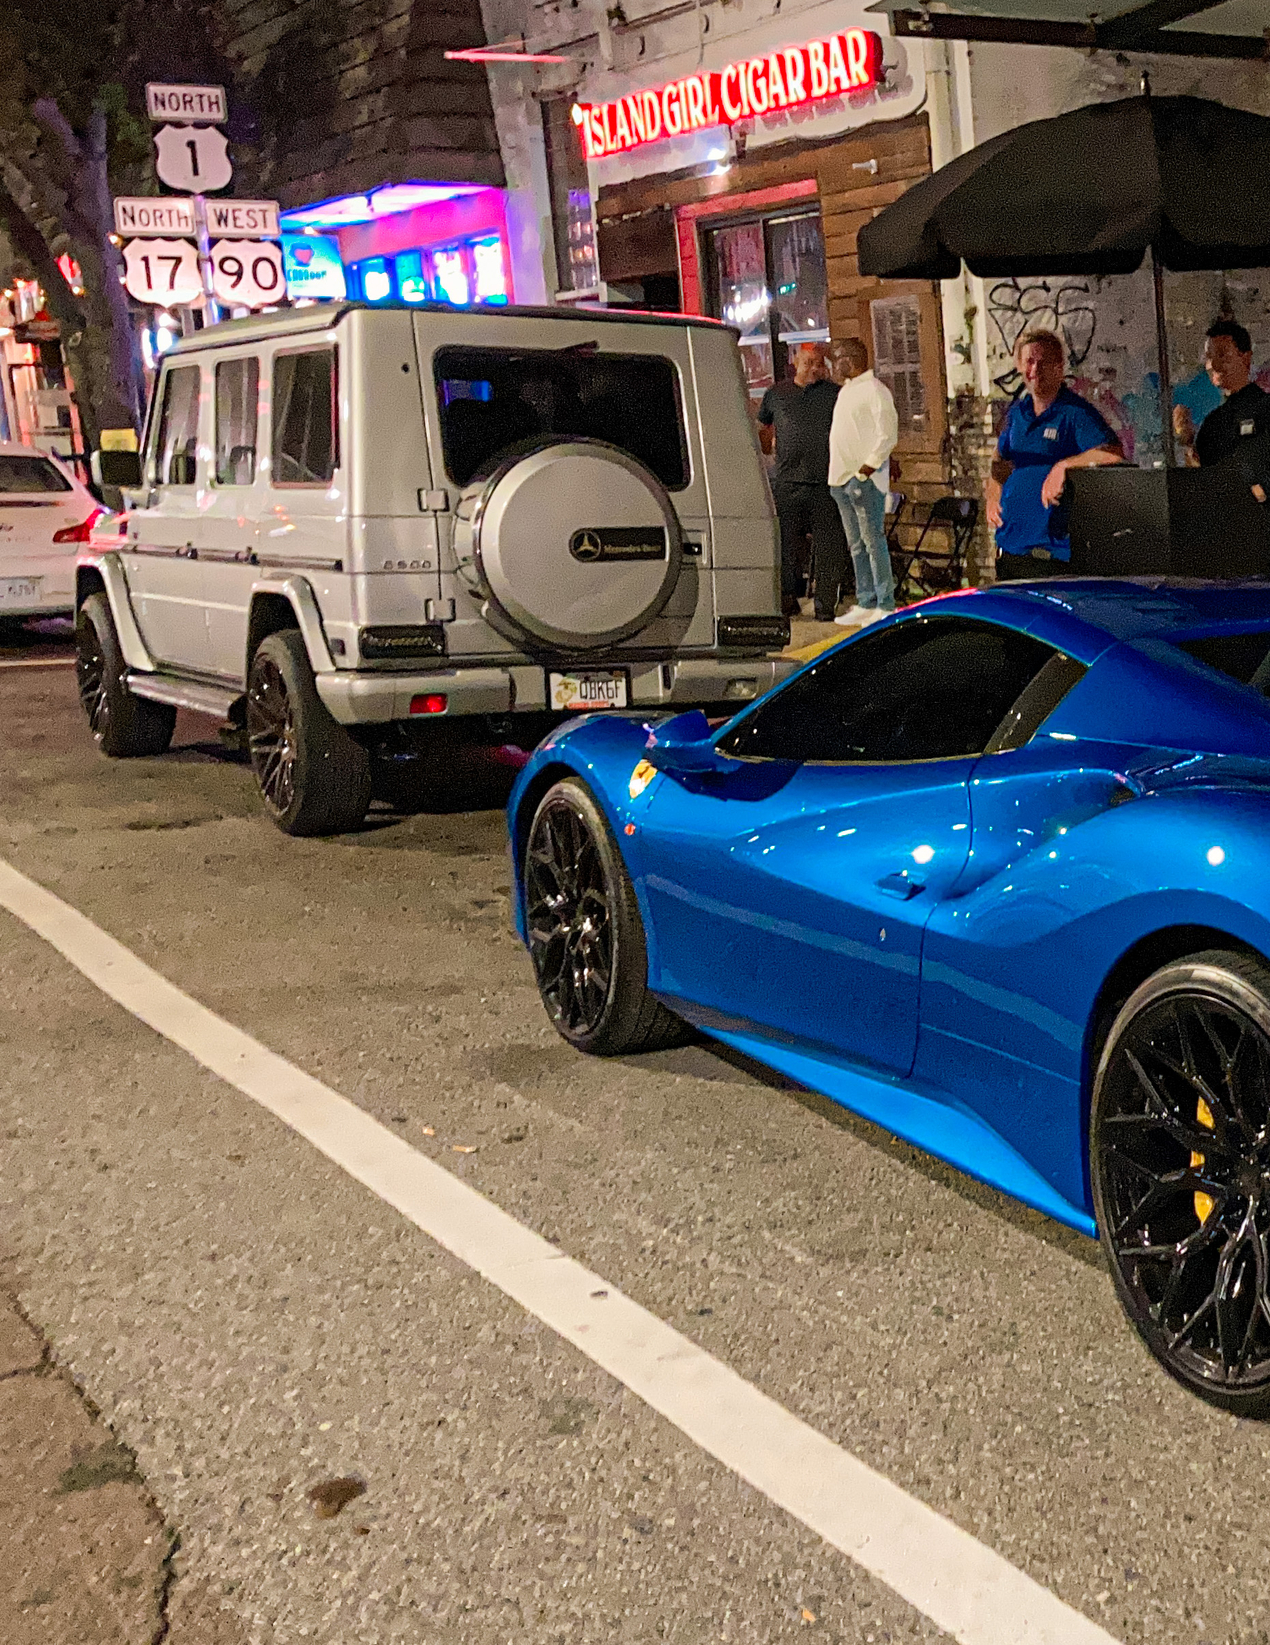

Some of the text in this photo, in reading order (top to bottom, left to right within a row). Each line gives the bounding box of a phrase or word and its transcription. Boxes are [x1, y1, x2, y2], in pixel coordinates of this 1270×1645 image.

[153, 92, 221, 113] NORTH
[582, 31, 869, 156] ISLAND GIRL CIGAR BAR
[186, 140, 199, 176] 1
[121, 205, 190, 228] NORTH
[213, 208, 270, 229] WEST
[140, 255, 182, 290] 17
[218, 256, 279, 290] 90
